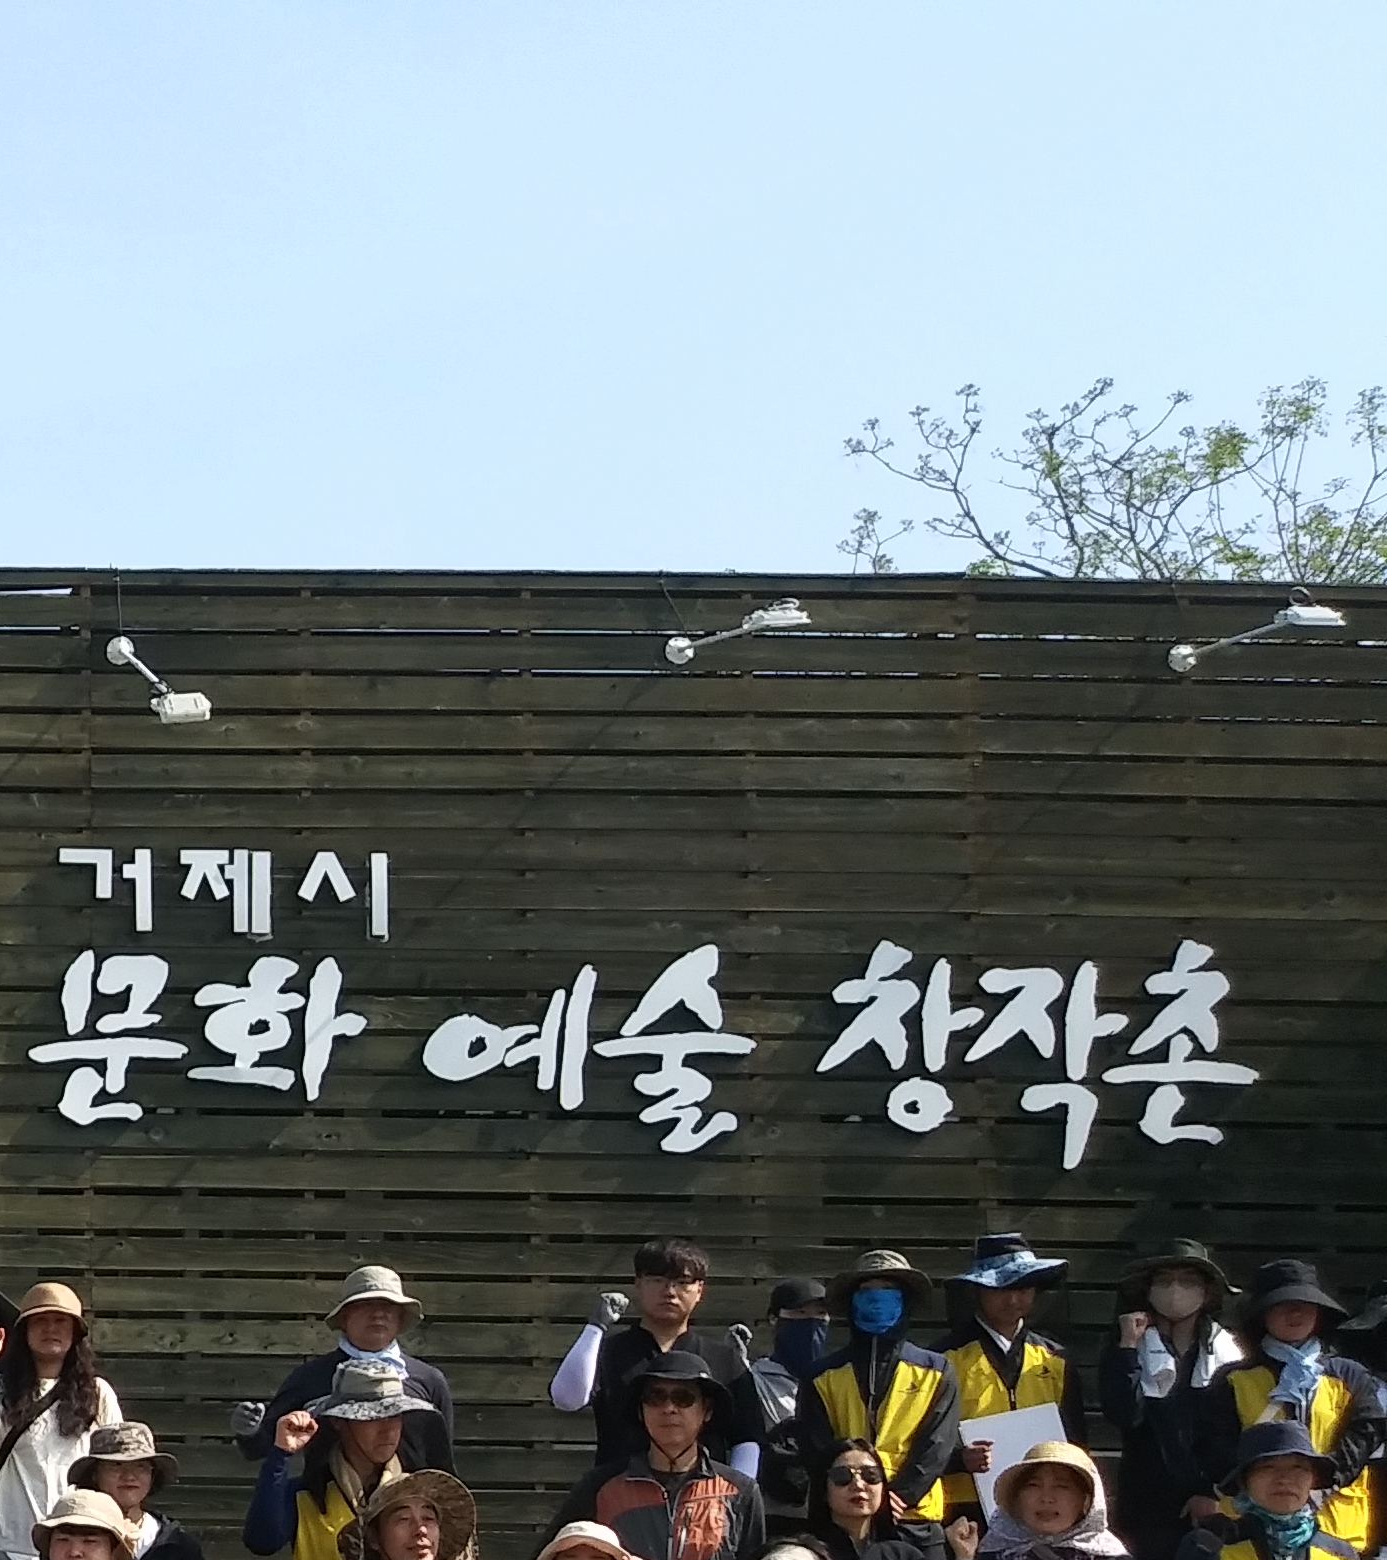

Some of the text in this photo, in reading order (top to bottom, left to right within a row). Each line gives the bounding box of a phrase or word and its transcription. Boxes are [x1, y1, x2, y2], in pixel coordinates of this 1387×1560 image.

[58, 846, 389, 938] 거제시
[28, 939, 1260, 1170] 문화 예술 창작촌
